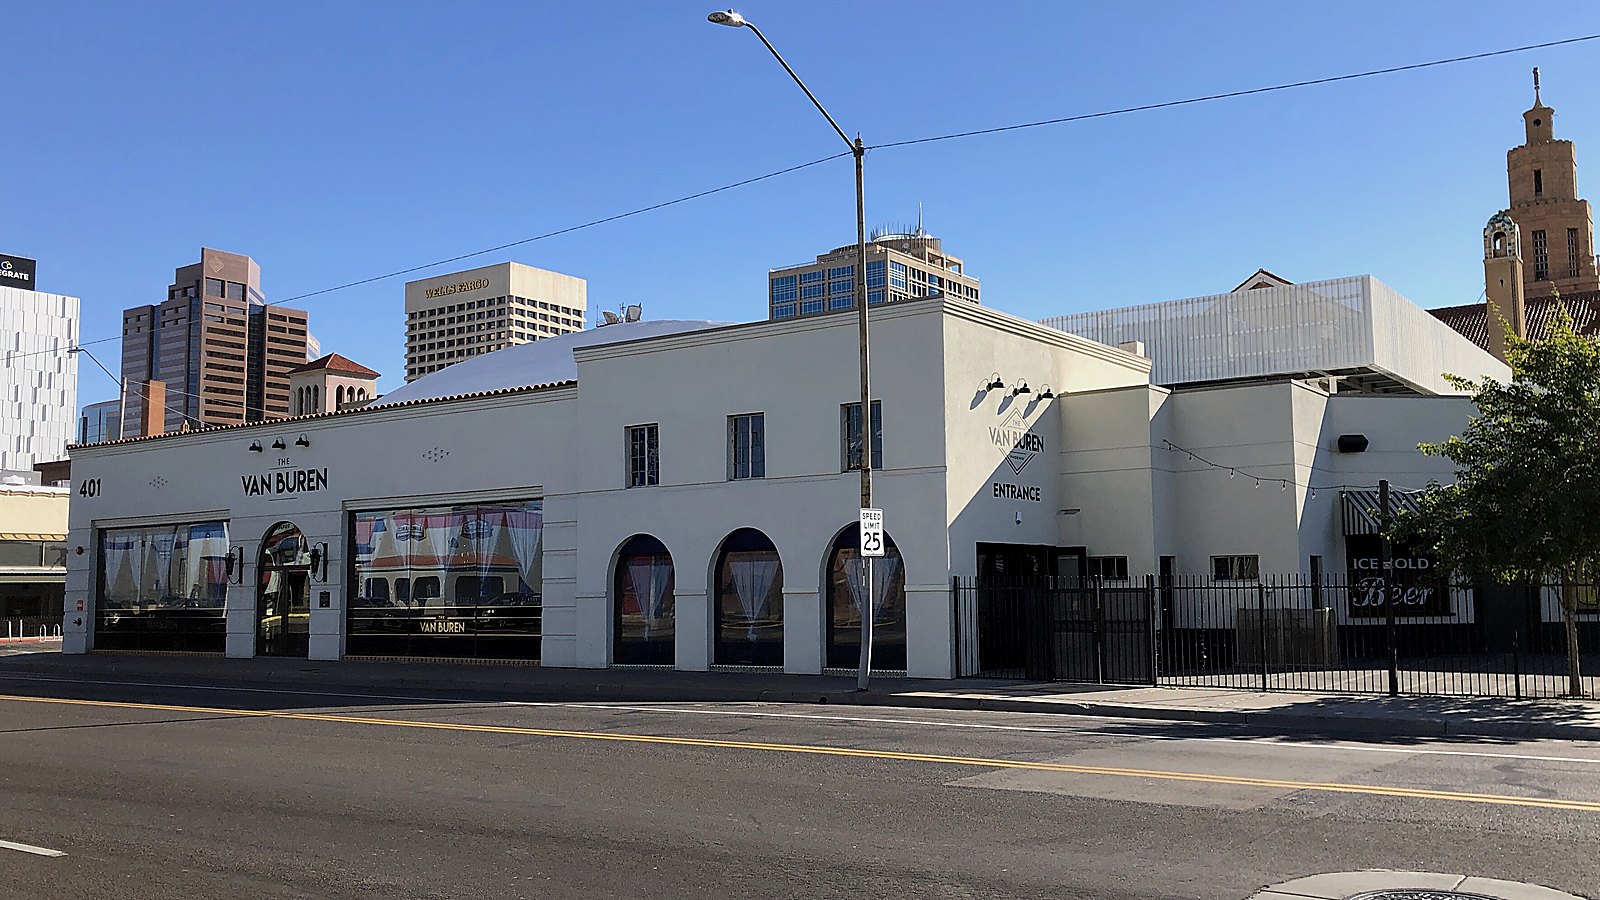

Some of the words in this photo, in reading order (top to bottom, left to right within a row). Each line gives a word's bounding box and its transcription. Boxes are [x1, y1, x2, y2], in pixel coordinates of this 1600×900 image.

[425, 285, 456, 298] WELLS
[457, 278, 489, 293] FARGO
[989, 426, 1010, 447] VAN
[1012, 430, 1044, 452] BUREN
[278, 458, 290, 466] THE
[80, 478, 102, 498] 401
[241, 473, 272, 497] VAN
[276, 468, 328, 494] BUREN
[993, 483, 1041, 501] ENTRANCE
[862, 512, 881, 520] SPEED
[864, 531, 880, 550] 25
[1353, 558, 1379, 569] ICE
[1389, 558, 1429, 569] OLD
[420, 622, 436, 633] VAN
[438, 622, 465, 633] BUREN
